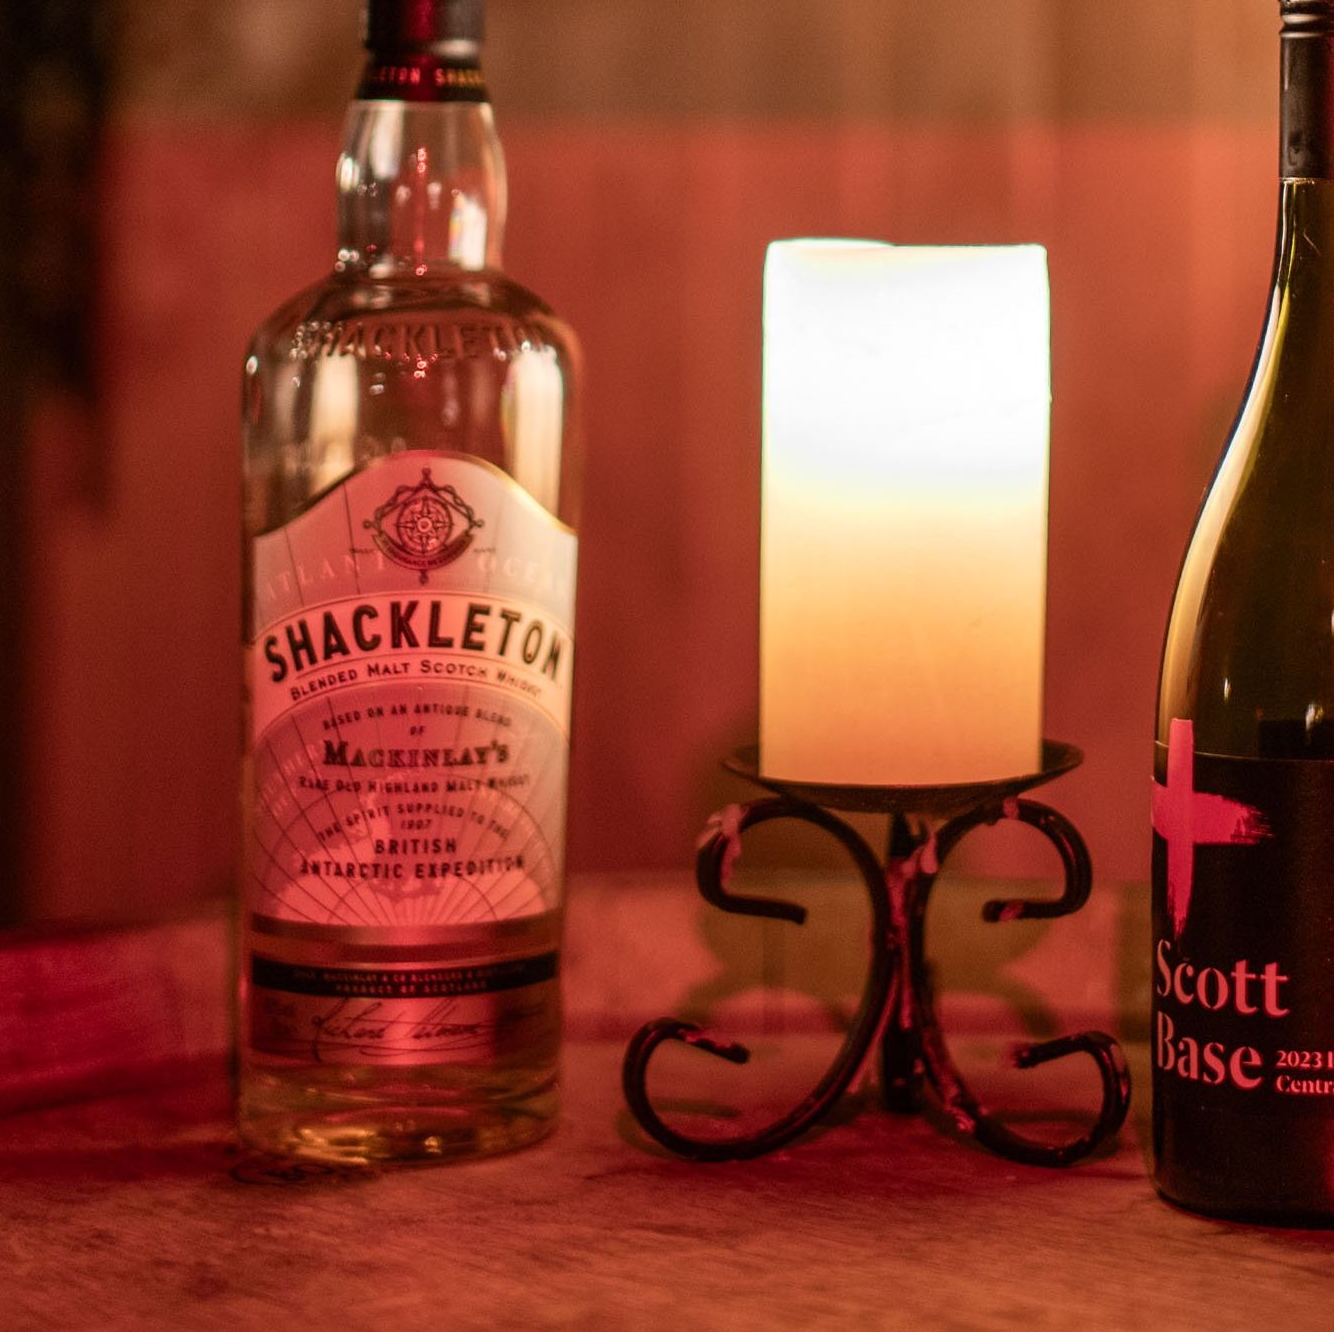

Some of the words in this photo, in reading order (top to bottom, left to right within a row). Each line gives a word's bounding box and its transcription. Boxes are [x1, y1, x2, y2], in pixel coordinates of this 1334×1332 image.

[264, 600, 563, 683] SHACKLETON
[290, 668, 358, 701] BLENDED
[367, 661, 410, 677] MALT
[420, 659, 488, 678] SCOTCH
[323, 709, 361, 730] BASED
[368, 706, 385, 718] ON
[391, 704, 407, 716] AN
[414, 703, 470, 717] ANTIQUE
[475, 706, 512, 728] BLEND
[322, 739, 510, 768] MACKINLAY'S
[298, 775, 330, 791] RARE
[368, 779, 440, 794] HIGHLAND
[319, 823, 343, 842] THE
[345, 806, 390, 827] SPIRIT
[396, 803, 466, 818] SUPPLIED
[374, 838, 457, 856] BRITISH
[300, 857, 403, 880] ANTARCTIC
[414, 855, 525, 879] EXPEDITION
[1155, 937, 1291, 1019] Scott
[1156, 1009, 1263, 1090] Base
[1275, 1049, 1323, 1069] 2023
